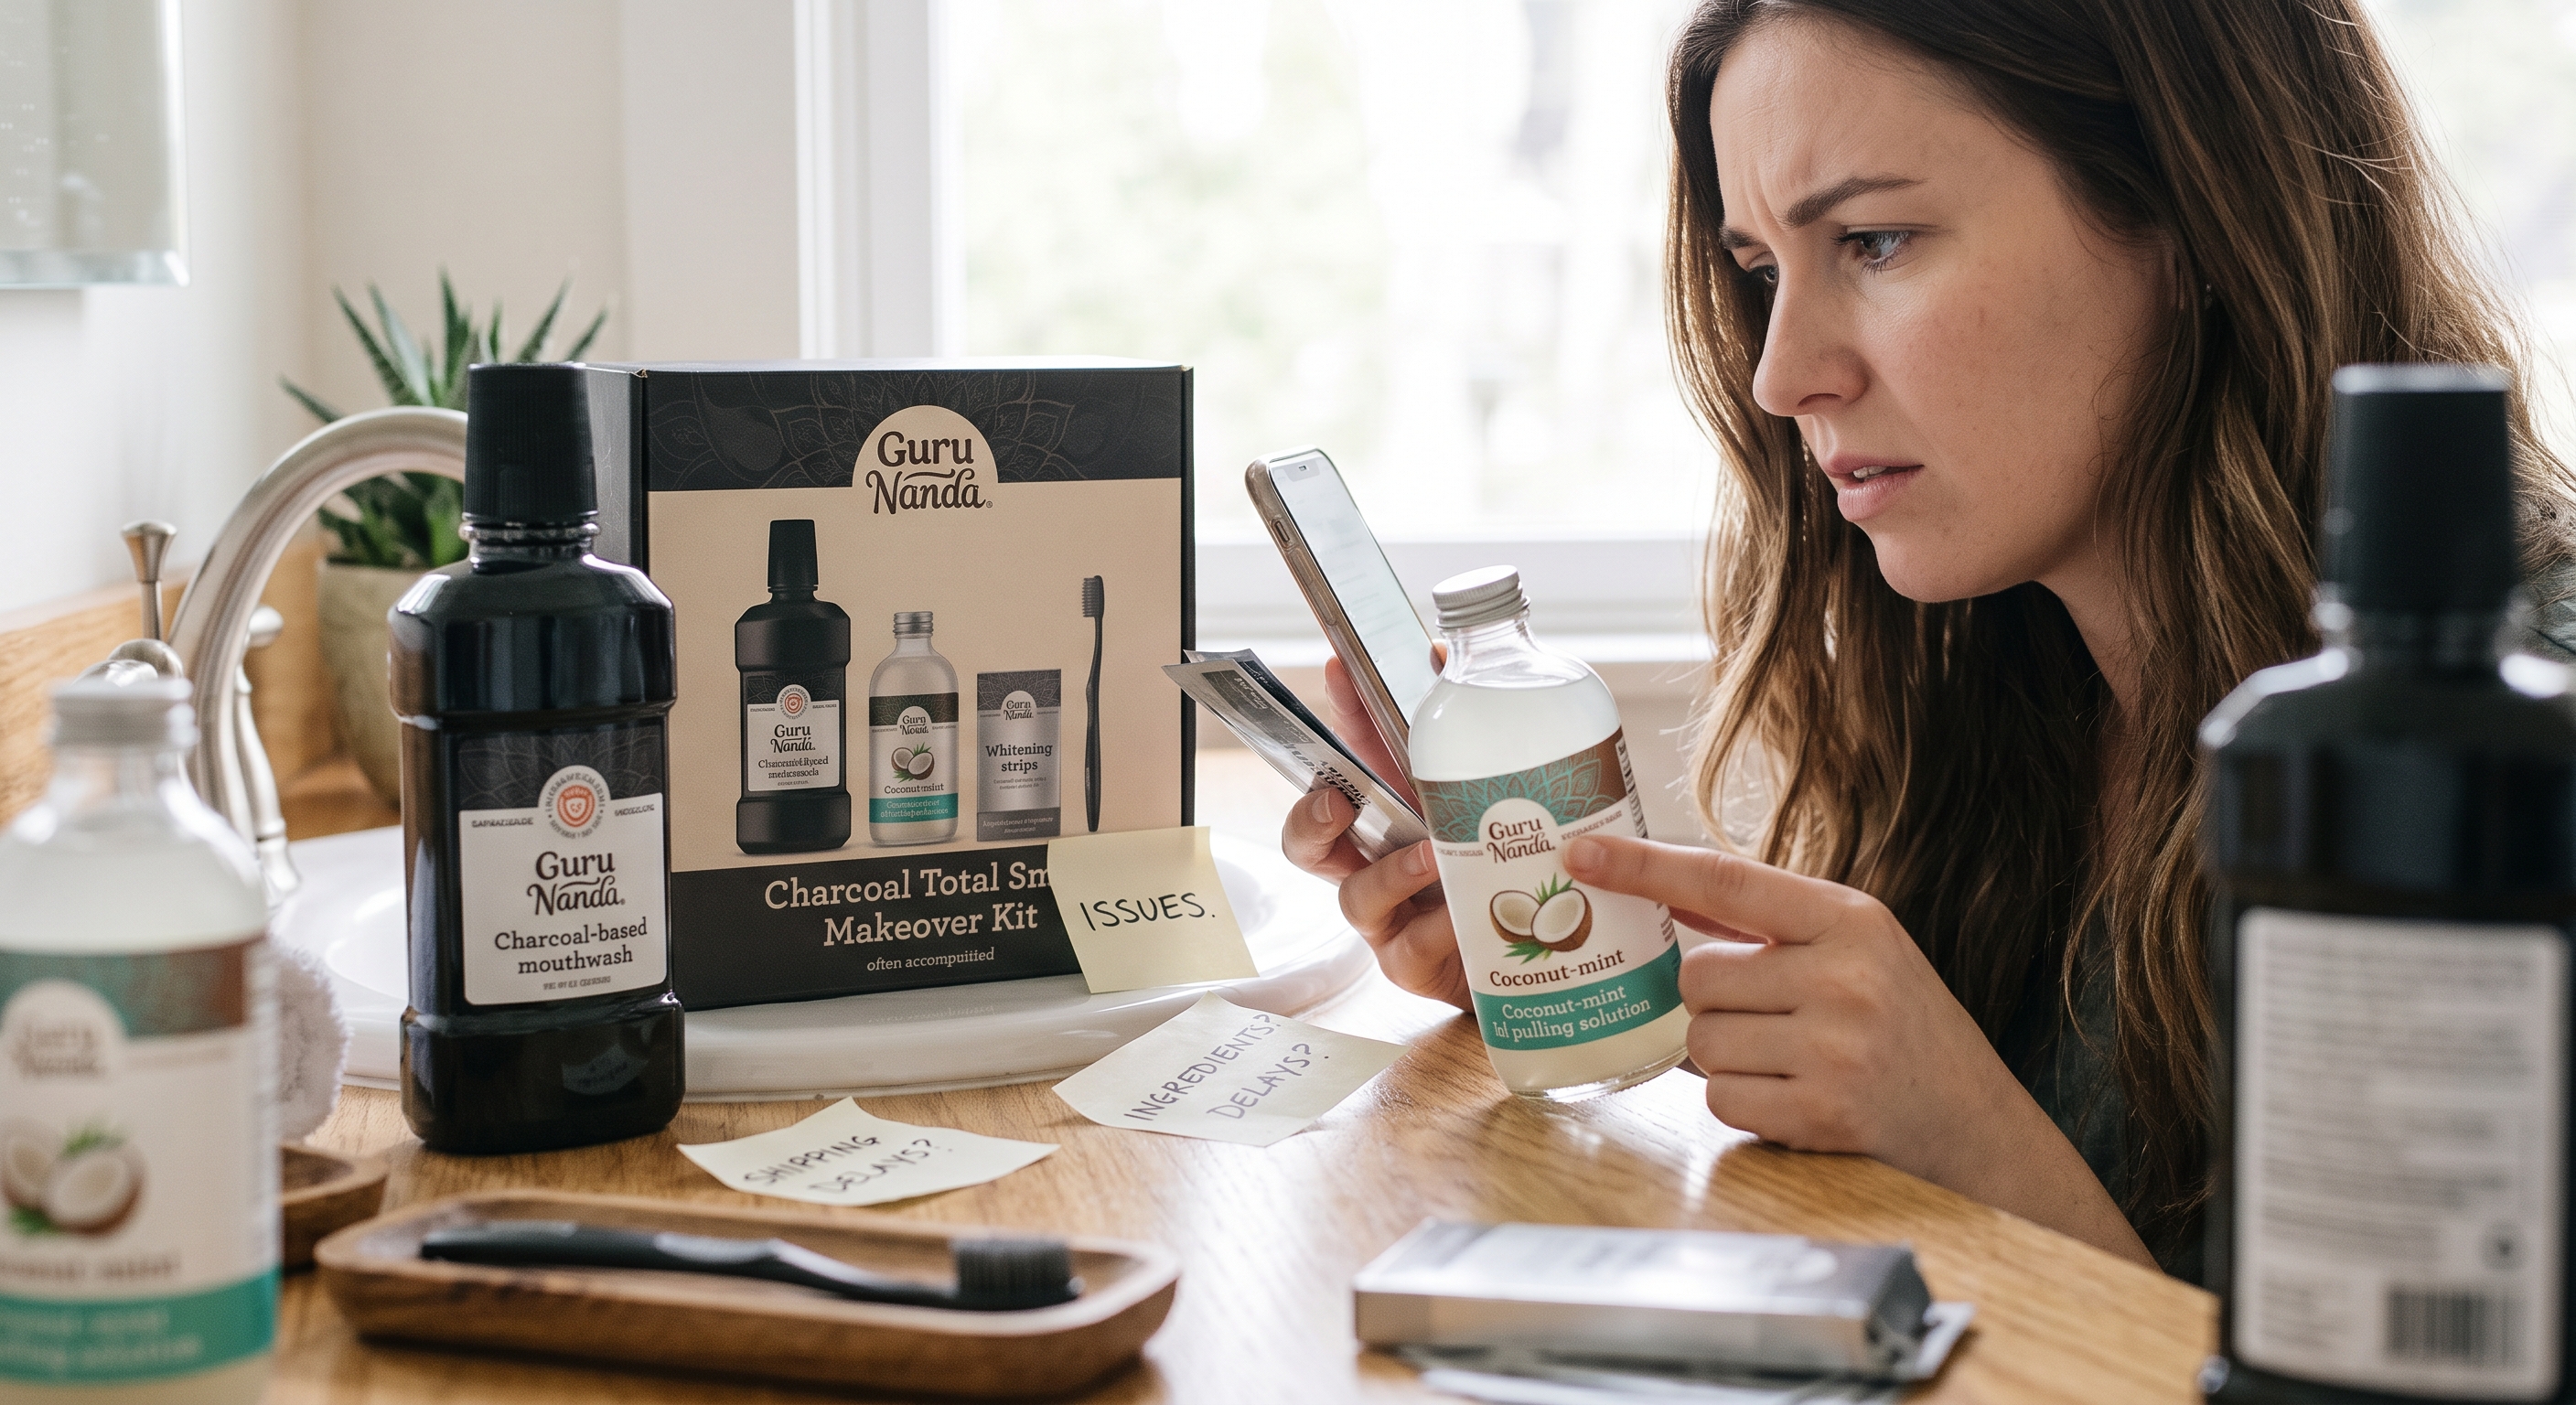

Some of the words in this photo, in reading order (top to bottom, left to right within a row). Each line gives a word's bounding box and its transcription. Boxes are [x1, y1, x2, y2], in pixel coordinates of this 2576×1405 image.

[877, 431, 974, 467] Guru
[865, 468, 987, 514] Nanda
[774, 724, 811, 738] Guru
[985, 743, 1054, 757] Whitening
[1001, 759, 1038, 774] strips
[1487, 831, 1554, 863] Nanda
[1488, 818, 1543, 841] Guru
[535, 851, 616, 881] Guru
[527, 875, 621, 916] Nanda
[765, 869, 912, 909] Charcoal
[919, 862, 1000, 896] Total
[495, 917, 648, 950] Charcoal-based
[823, 912, 983, 947] Makeover
[992, 902, 1038, 932] Kit
[518, 944, 634, 974] mouthwash
[866, 957, 902, 971] often
[1489, 949, 1626, 987] Coconut-mint
[1502, 985, 1626, 1020] Coconut-mint
[1511, 1020, 1575, 1043] pulling
[1579, 1000, 1651, 1031] solution
[1123, 1014, 1282, 1121] INGREDIENTS?
[1206, 1043, 1328, 1120] DELAYS?
[744, 1136, 881, 1185] SHIPPING
